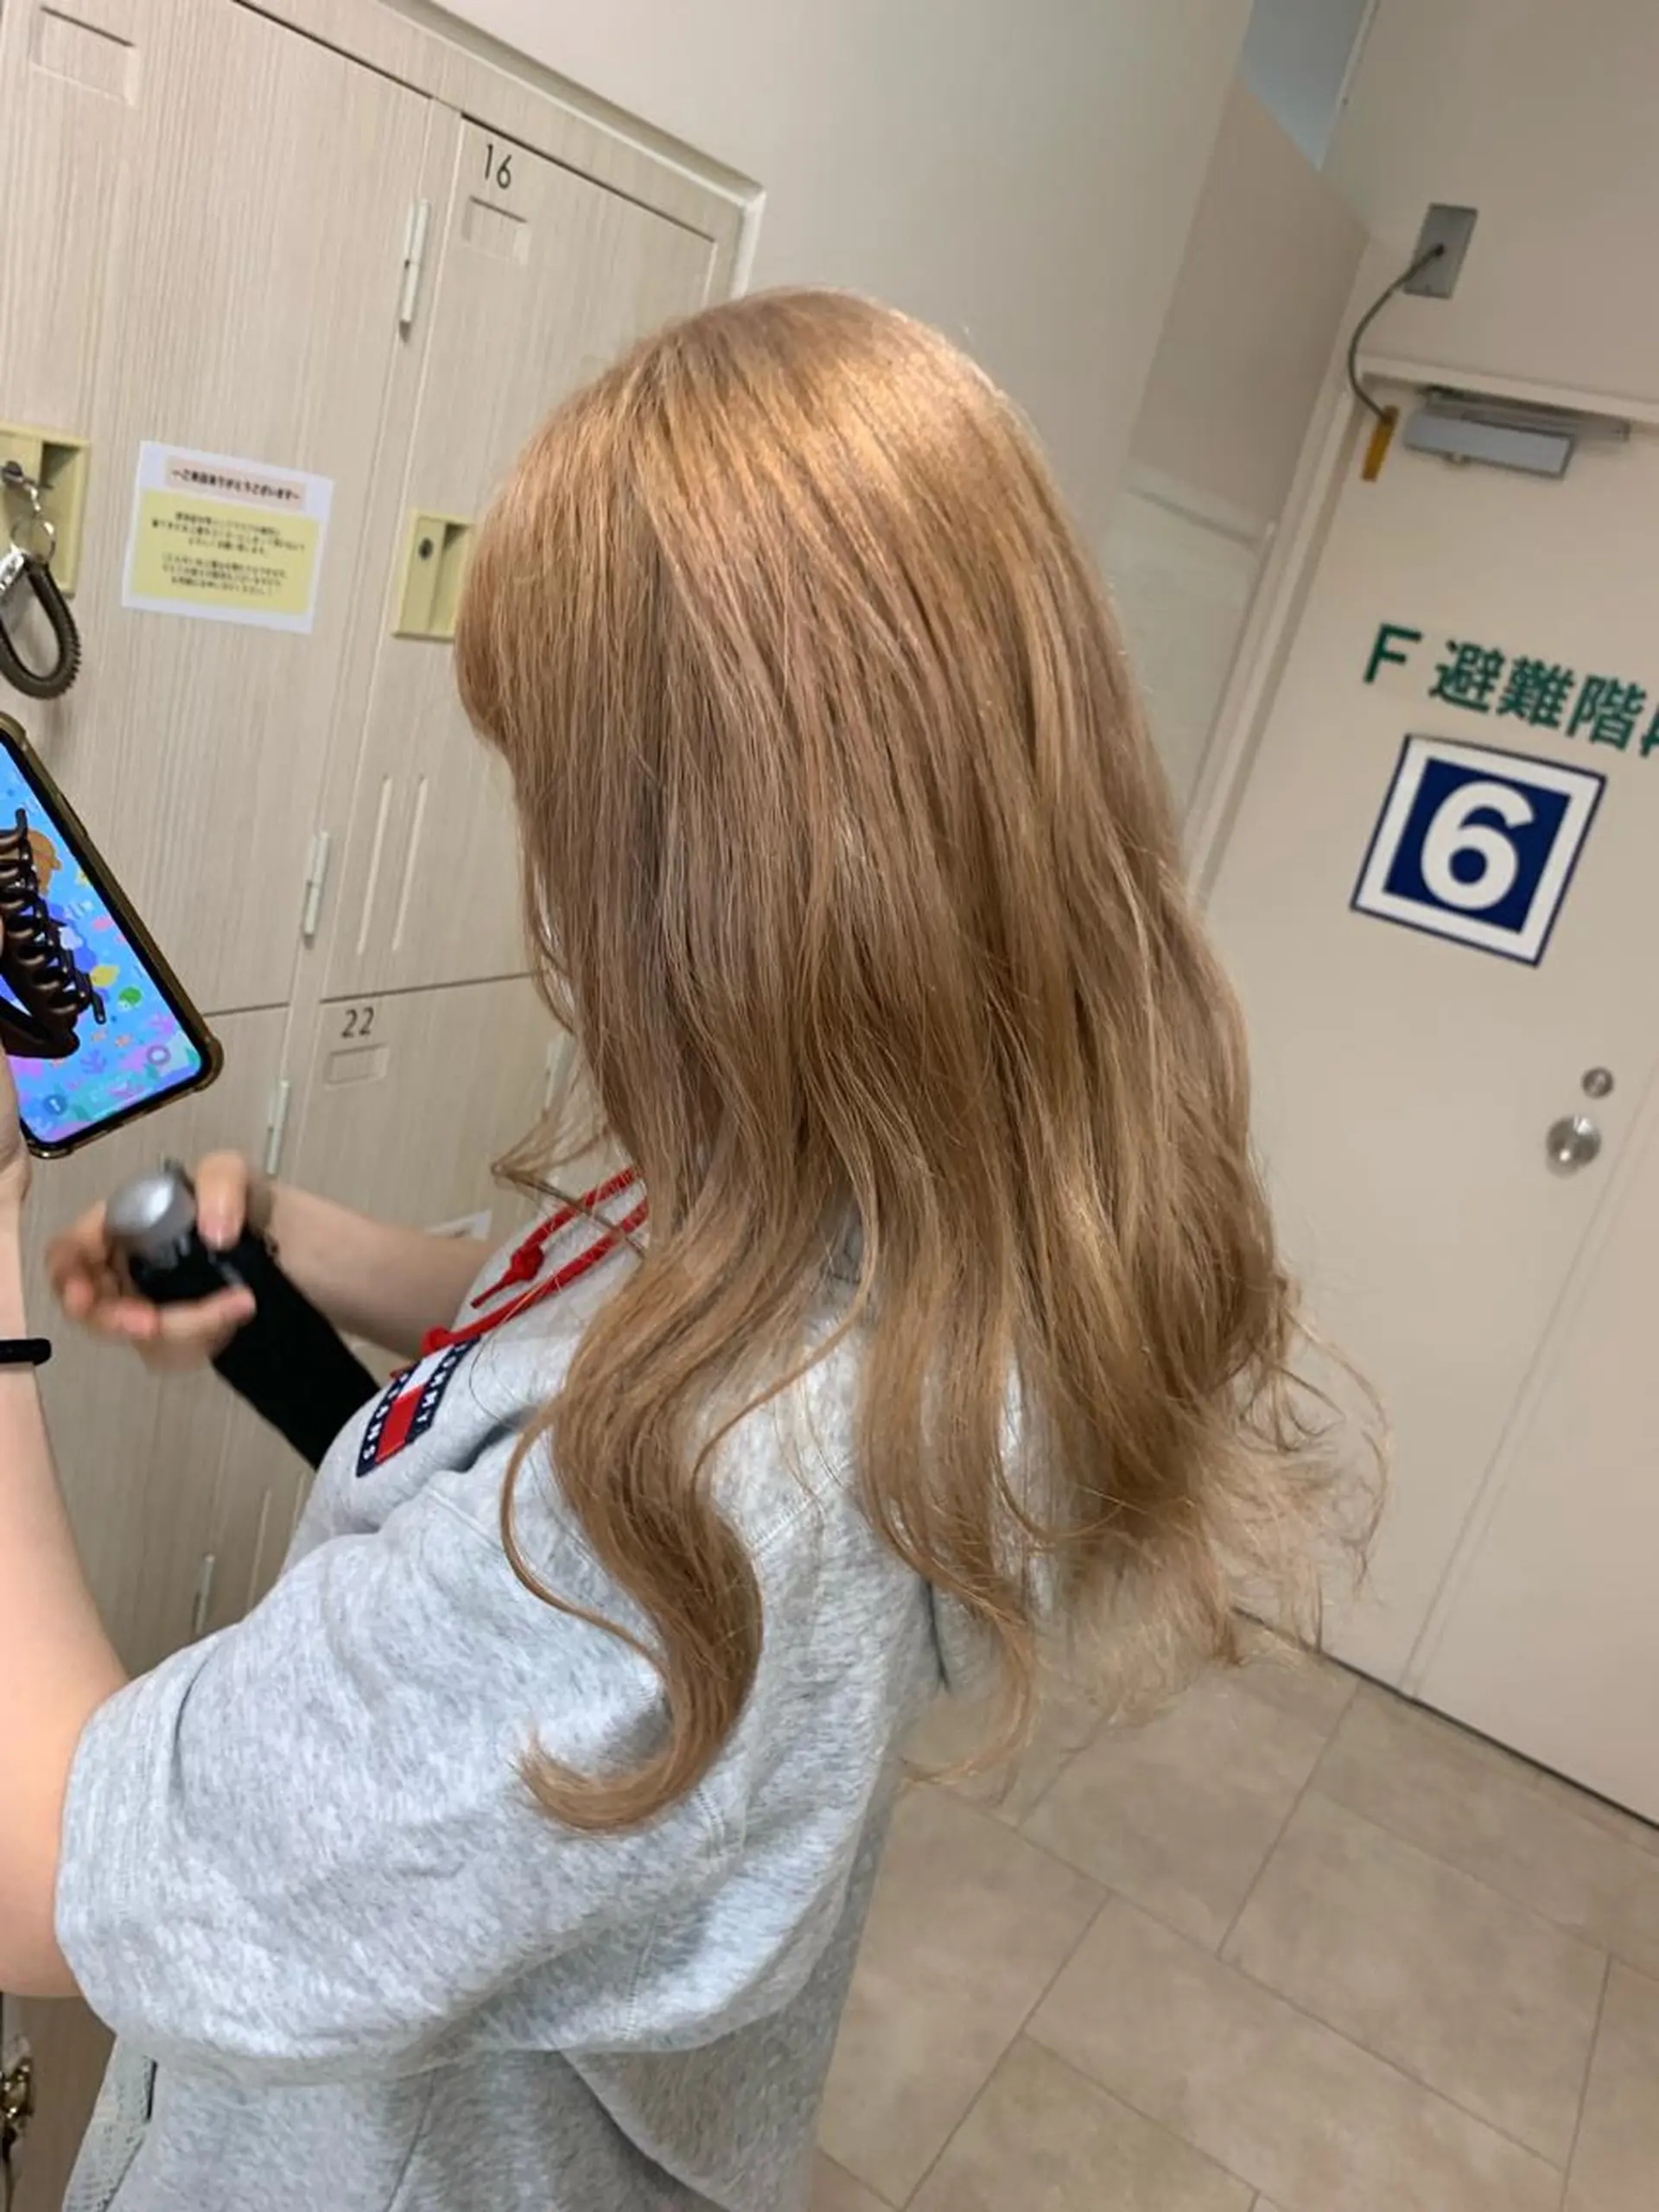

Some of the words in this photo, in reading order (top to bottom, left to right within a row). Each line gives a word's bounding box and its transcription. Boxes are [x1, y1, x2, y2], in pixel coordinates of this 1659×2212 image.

[485, 143, 512, 190] 16
[1363, 623, 1421, 684] F
[1421, 780, 1535, 911] 6
[341, 1006, 374, 1039] 22
